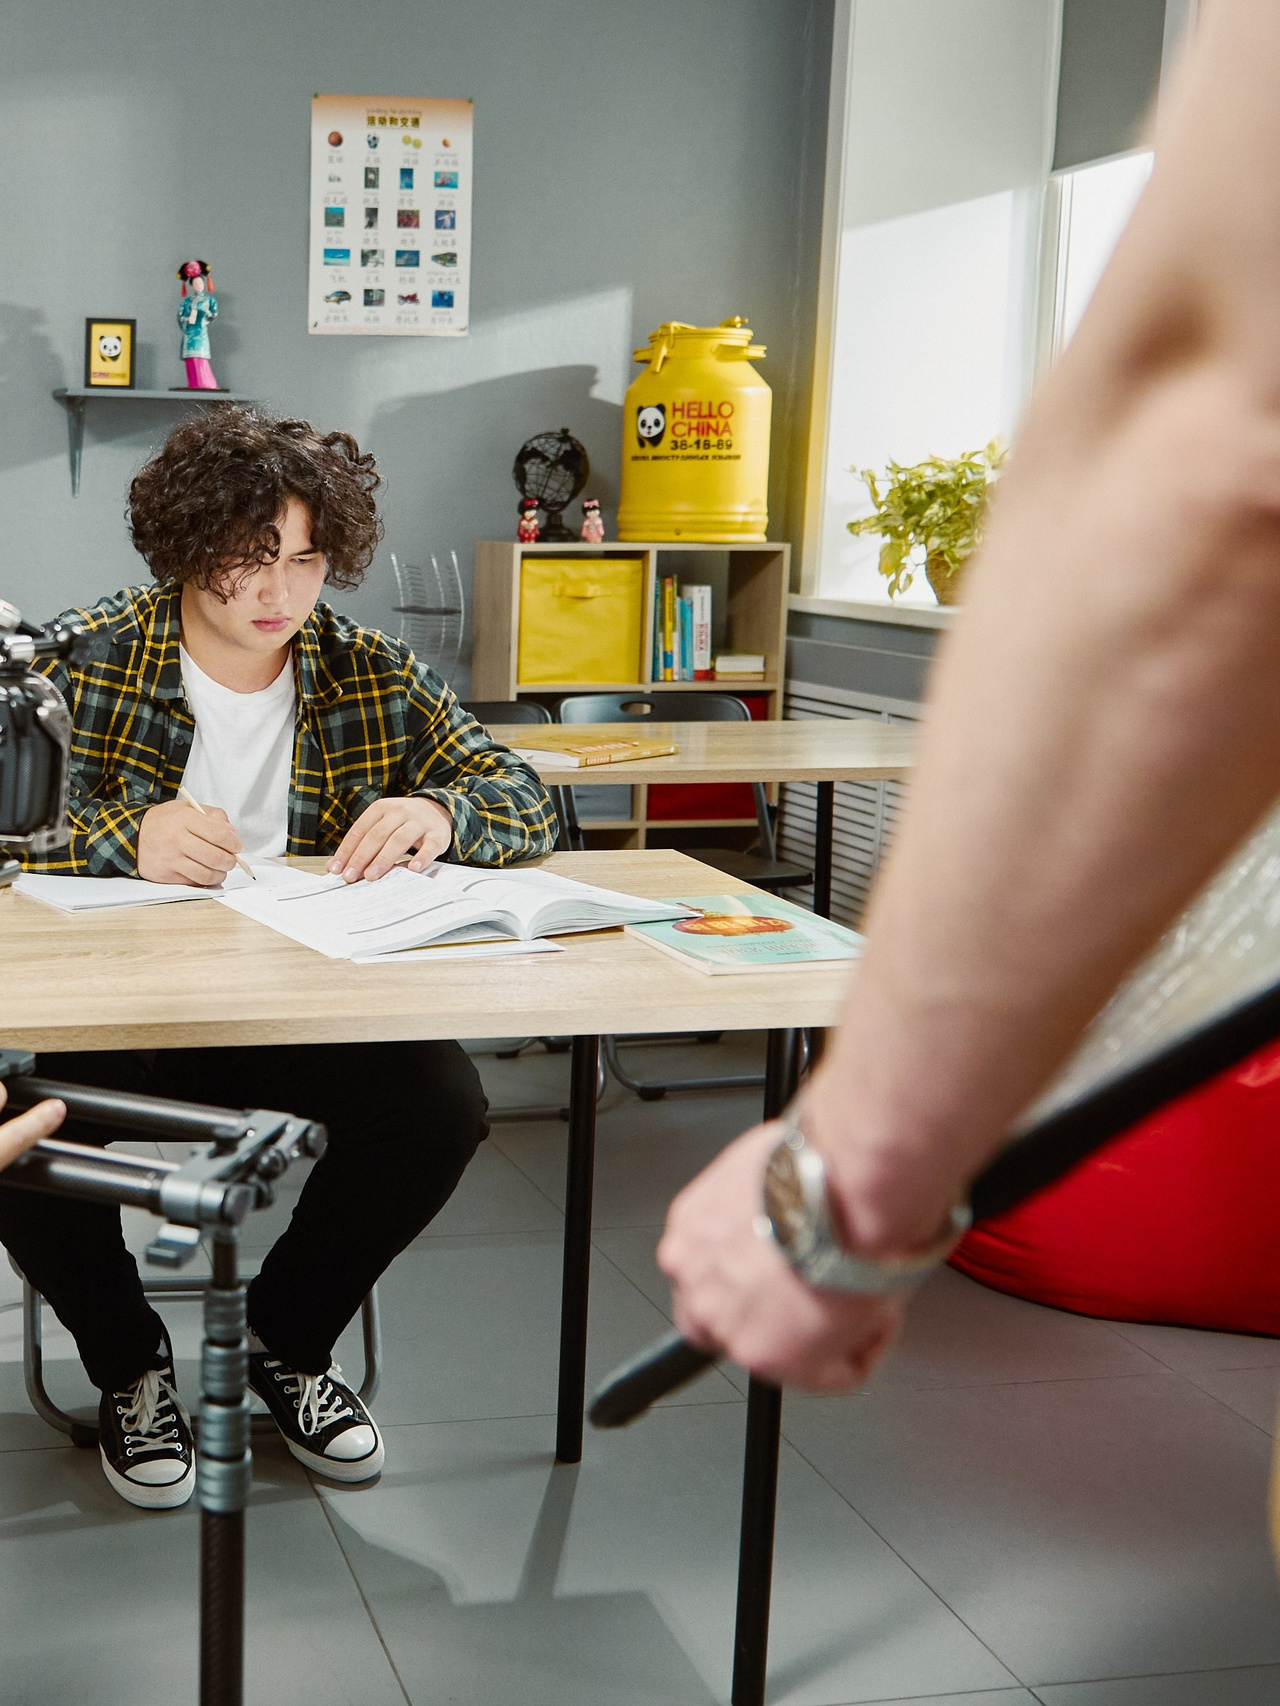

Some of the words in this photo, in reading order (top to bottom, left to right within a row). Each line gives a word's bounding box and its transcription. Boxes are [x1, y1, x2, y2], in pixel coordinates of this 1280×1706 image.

[671, 401, 734, 419] HELLO
[671, 420, 733, 438] CHINA
[670, 439, 733, 451] 38-18-89
